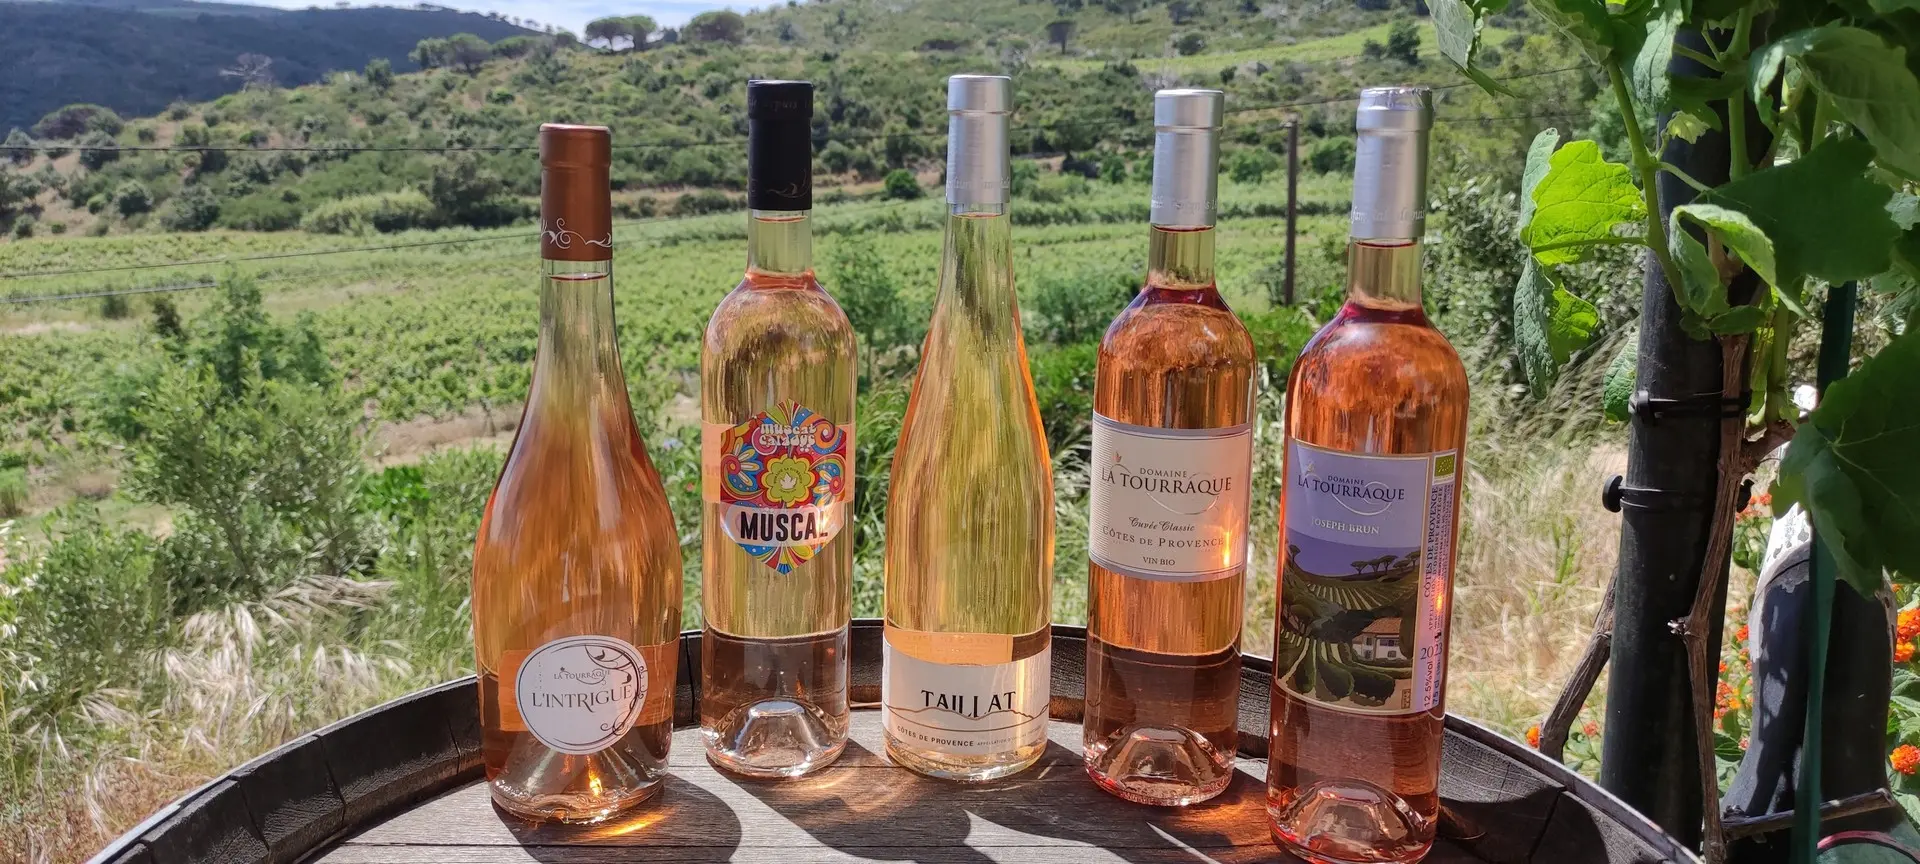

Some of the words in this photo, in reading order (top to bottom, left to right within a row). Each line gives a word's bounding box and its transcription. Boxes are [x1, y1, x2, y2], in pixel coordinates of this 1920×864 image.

[1140, 467, 1188, 478] DOMAINE
[1328, 475, 1364, 485] DOMAINE
[1102, 467, 1115, 485] LA
[1120, 473, 1232, 496] TOURRAQUE
[1298, 475, 1309, 488] LA
[1312, 479, 1405, 502] TOURRAQUE
[1129, 516, 1158, 530] Cuvée
[1159, 519, 1196, 532] Classic
[1427, 486, 1439, 545] PROVENCE
[1311, 517, 1345, 531] JOSEPH
[1349, 524, 1380, 535] BRUN
[1139, 537, 1153, 546] DE
[1159, 537, 1224, 548] PROVENCE
[1427, 544, 1434, 561] DE
[1143, 556, 1158, 565] VIN
[1160, 558, 1176, 567] BIO
[1423, 561, 1433, 598] CÔTES
[553, 672, 563, 680] LA
[565, 669, 611, 681] TOURRAQUE
[1433, 679, 1440, 689] cl
[532, 685, 633, 713] L'INTRIGUE
[921, 689, 1016, 718] TAILLAT
[1432, 691, 1439, 705] 75
[897, 725, 916, 739] CÔTES
[918, 734, 929, 742] DE
[931, 738, 974, 747] PROVENCE
